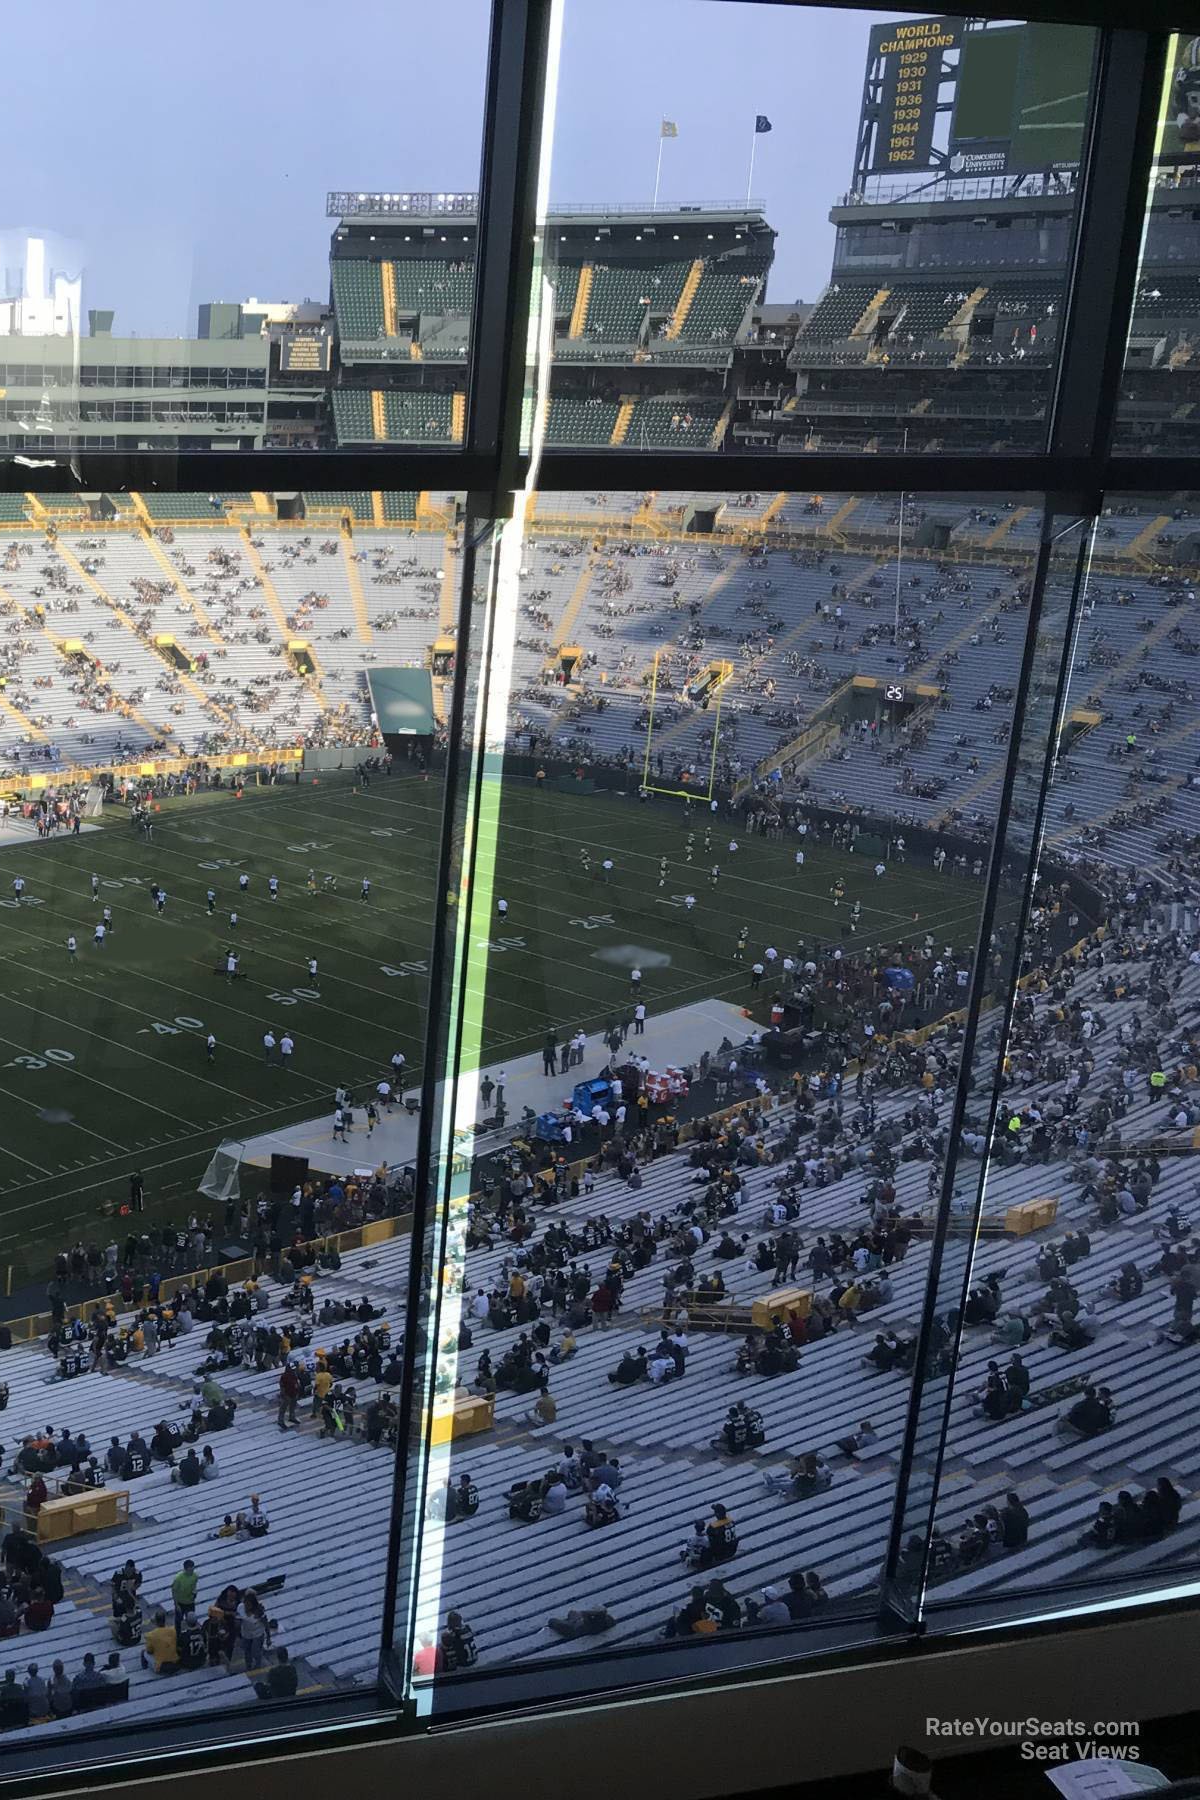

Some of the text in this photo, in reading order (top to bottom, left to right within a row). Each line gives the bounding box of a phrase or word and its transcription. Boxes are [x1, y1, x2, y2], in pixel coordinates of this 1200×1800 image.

[895, 23, 941, 38] WORLD
[879, 34, 954, 53] CHAMPIONS
[900, 52, 928, 64] 1929
[898, 66, 926, 78] 1930
[897, 80, 921, 92] 1931
[895, 94, 922, 106] 1936
[893, 108, 920, 120] 1939
[892, 122, 919, 134] 1944
[890, 136, 915, 148] 1961
[888, 150, 915, 162] 1962
[966, 152, 1005, 161] CONCORDIA
[965, 160, 1005, 168] UNIVERSITY
[887, 686, 902, 699] 25
[568, 915, 615, 930] 20
[379, 961, 428, 976] 40
[265, 988, 321, 1006] 50
[150, 1016, 204, 1035] 40
[13, 1048, 75, 1070] 30
[132, 1460, 143, 1472] 12
[94, 1472, 104, 1485] 12
[469, 1493, 479, 1504] 87
